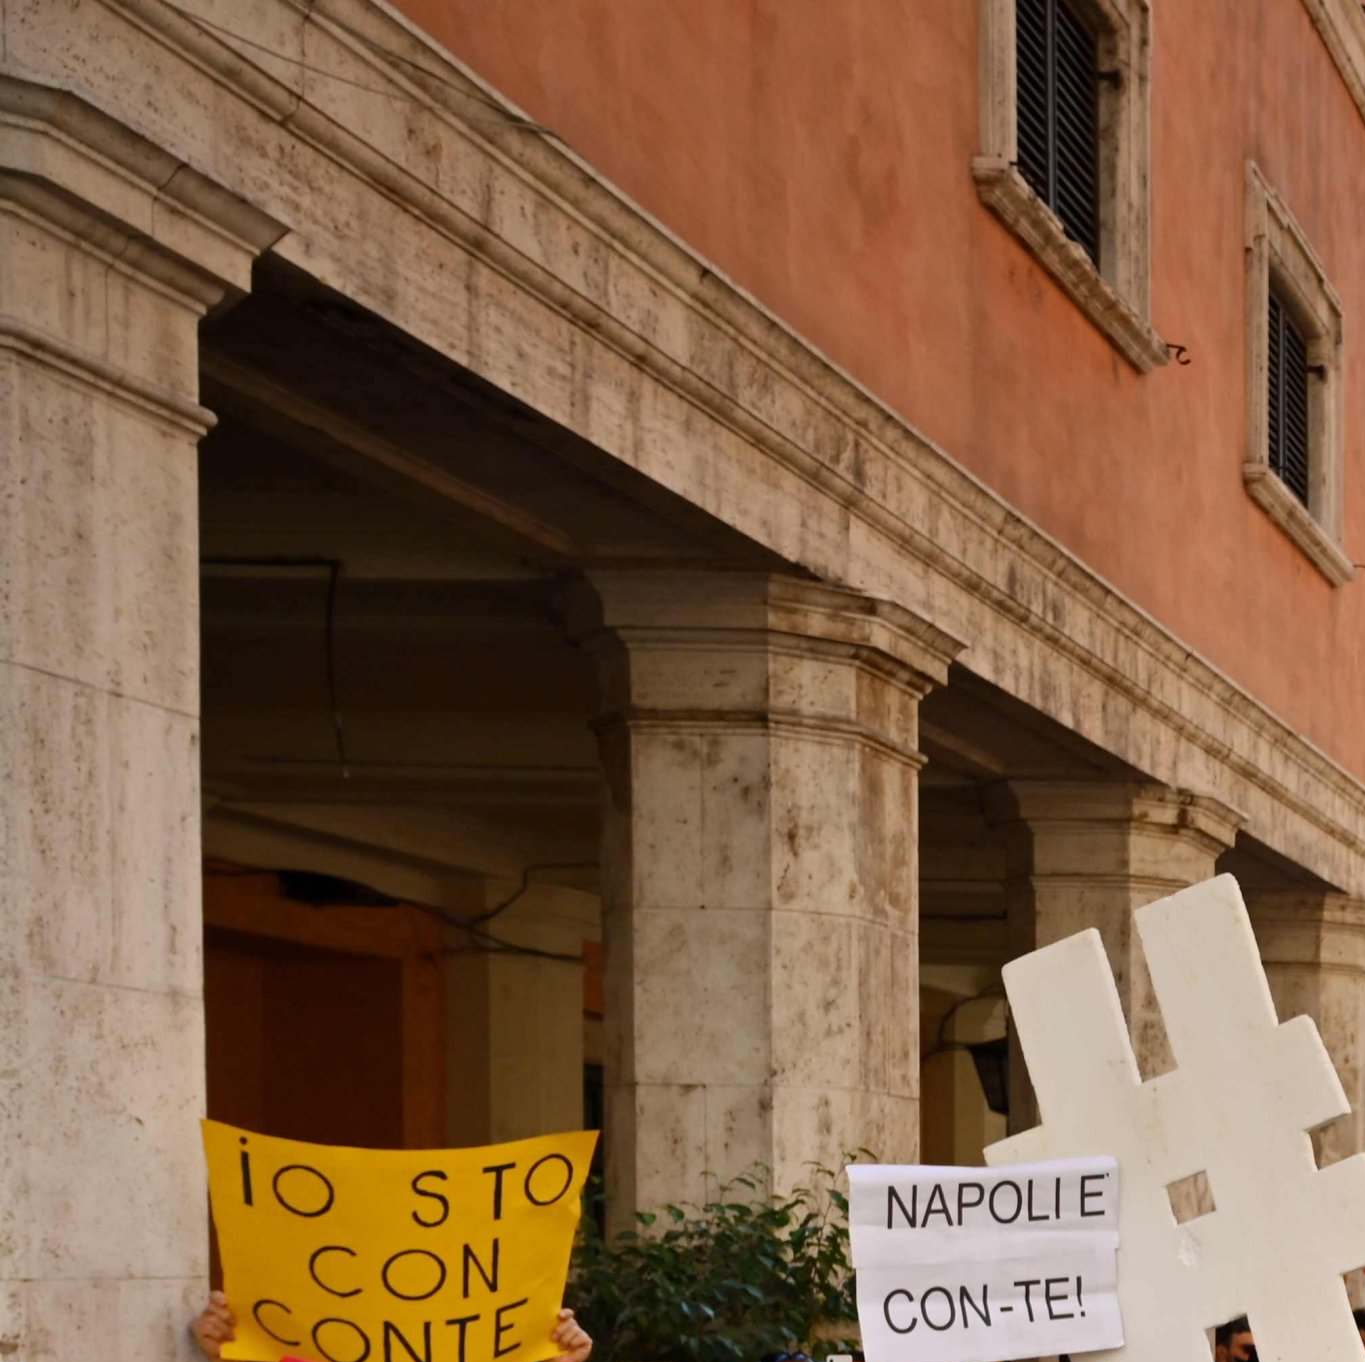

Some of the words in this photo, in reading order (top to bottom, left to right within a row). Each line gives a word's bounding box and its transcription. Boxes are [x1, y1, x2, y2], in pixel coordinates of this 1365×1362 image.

[886, 1177, 1061, 1230] NAPOLI
[307, 1237, 500, 1302] CON
[882, 1275, 1087, 1335] CON-TE!
